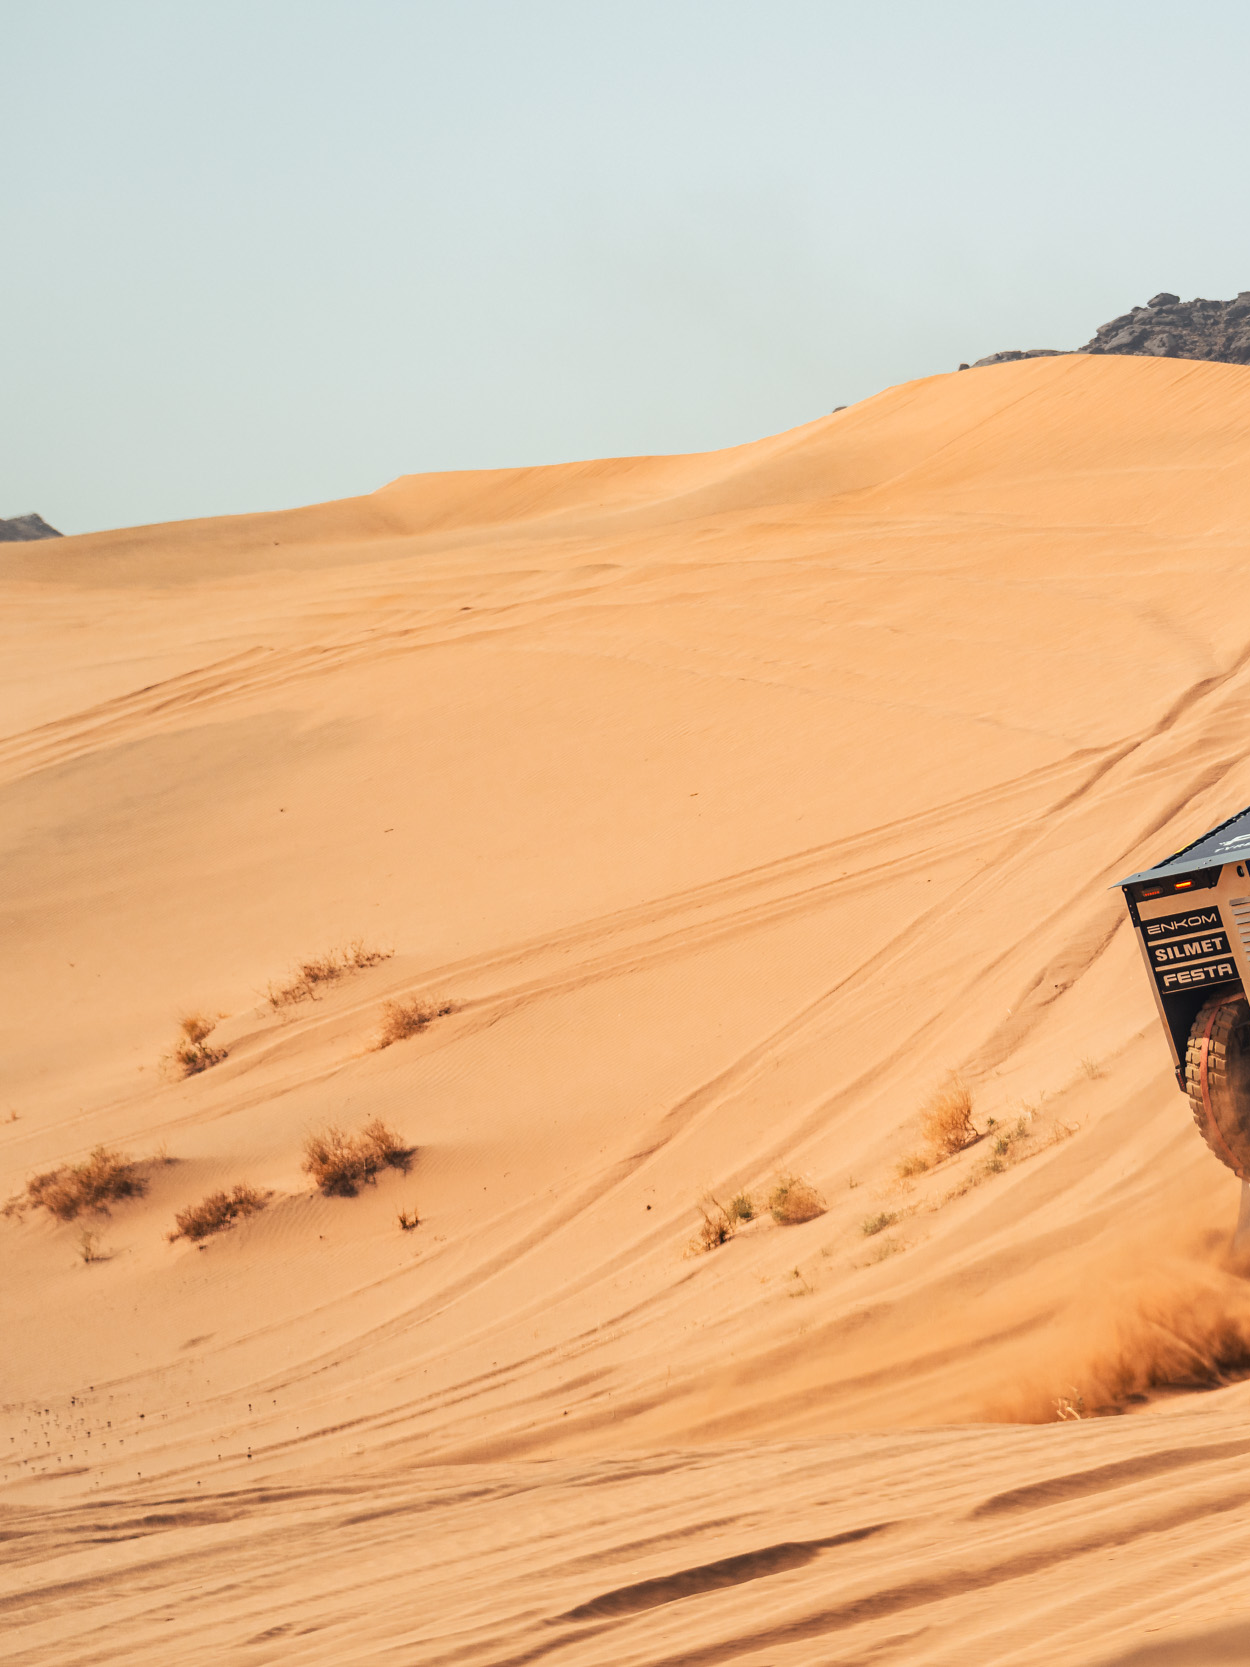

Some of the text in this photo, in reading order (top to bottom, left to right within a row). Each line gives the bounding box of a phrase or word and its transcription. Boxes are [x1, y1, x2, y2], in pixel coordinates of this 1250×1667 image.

[1147, 913, 1217, 934] ENKOM
[1155, 937, 1222, 961] SILMET
[1163, 963, 1232, 986] FESTA
